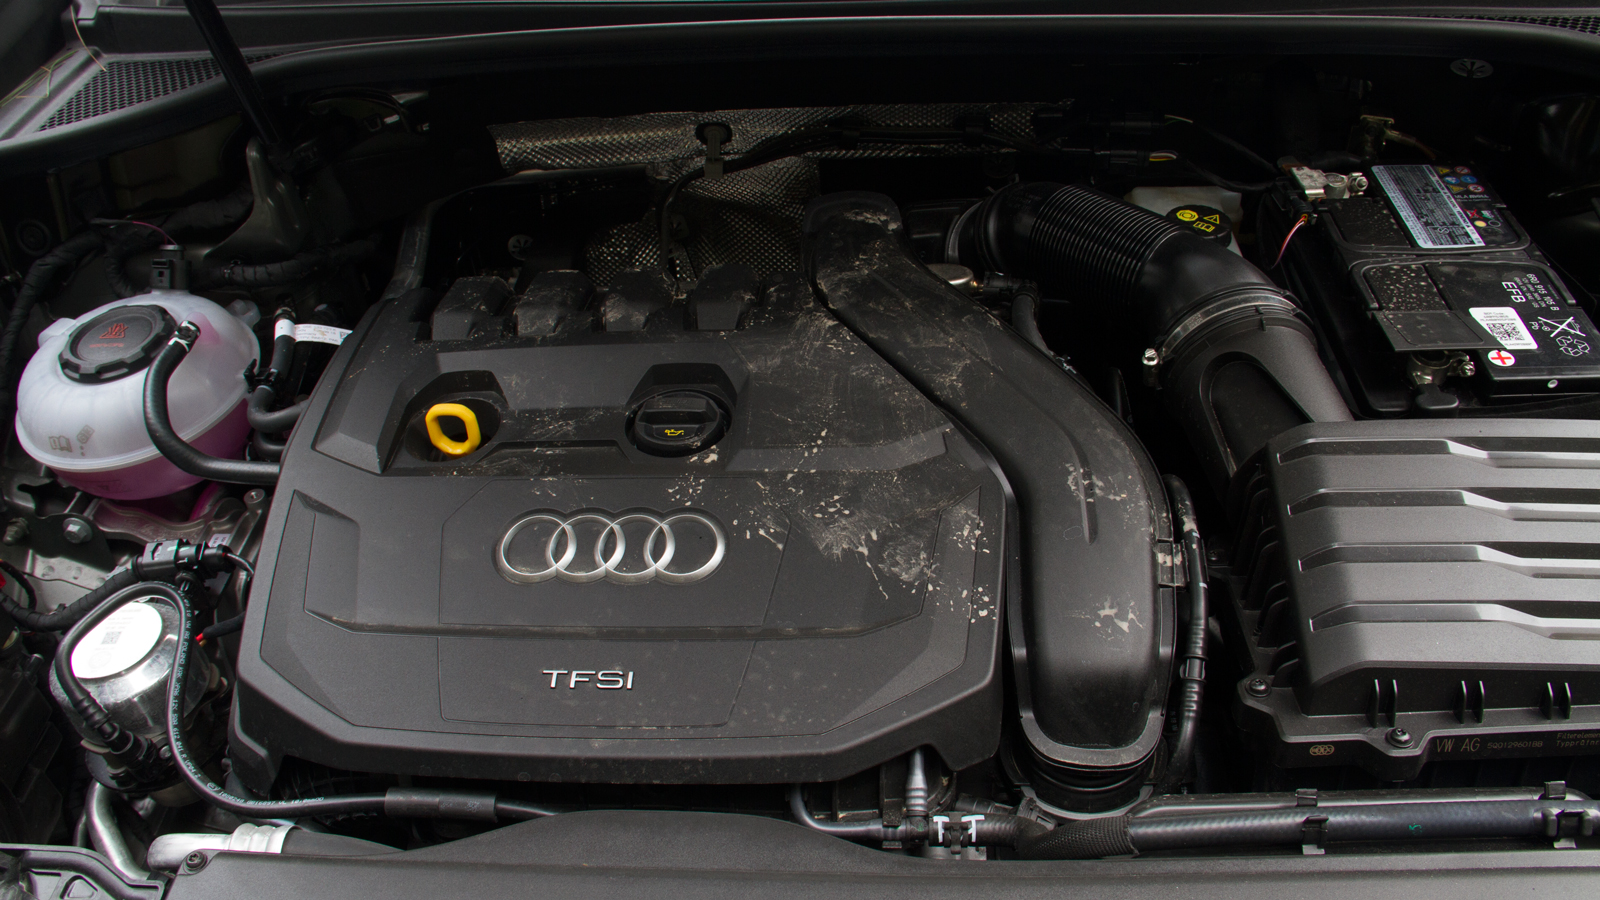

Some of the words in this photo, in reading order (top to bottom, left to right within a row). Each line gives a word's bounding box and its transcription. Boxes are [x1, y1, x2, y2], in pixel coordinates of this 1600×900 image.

[1501, 281, 1527, 303] EFB
[1534, 284, 1548, 294] 915
[179, 641, 189, 665] POLAND
[542, 669, 635, 690] TFSI
[172, 727, 181, 739] 612
[1436, 738, 1455, 753] VW
[1460, 737, 1481, 753] AG
[1487, 740, 1544, 750] 5Q0129601BB
